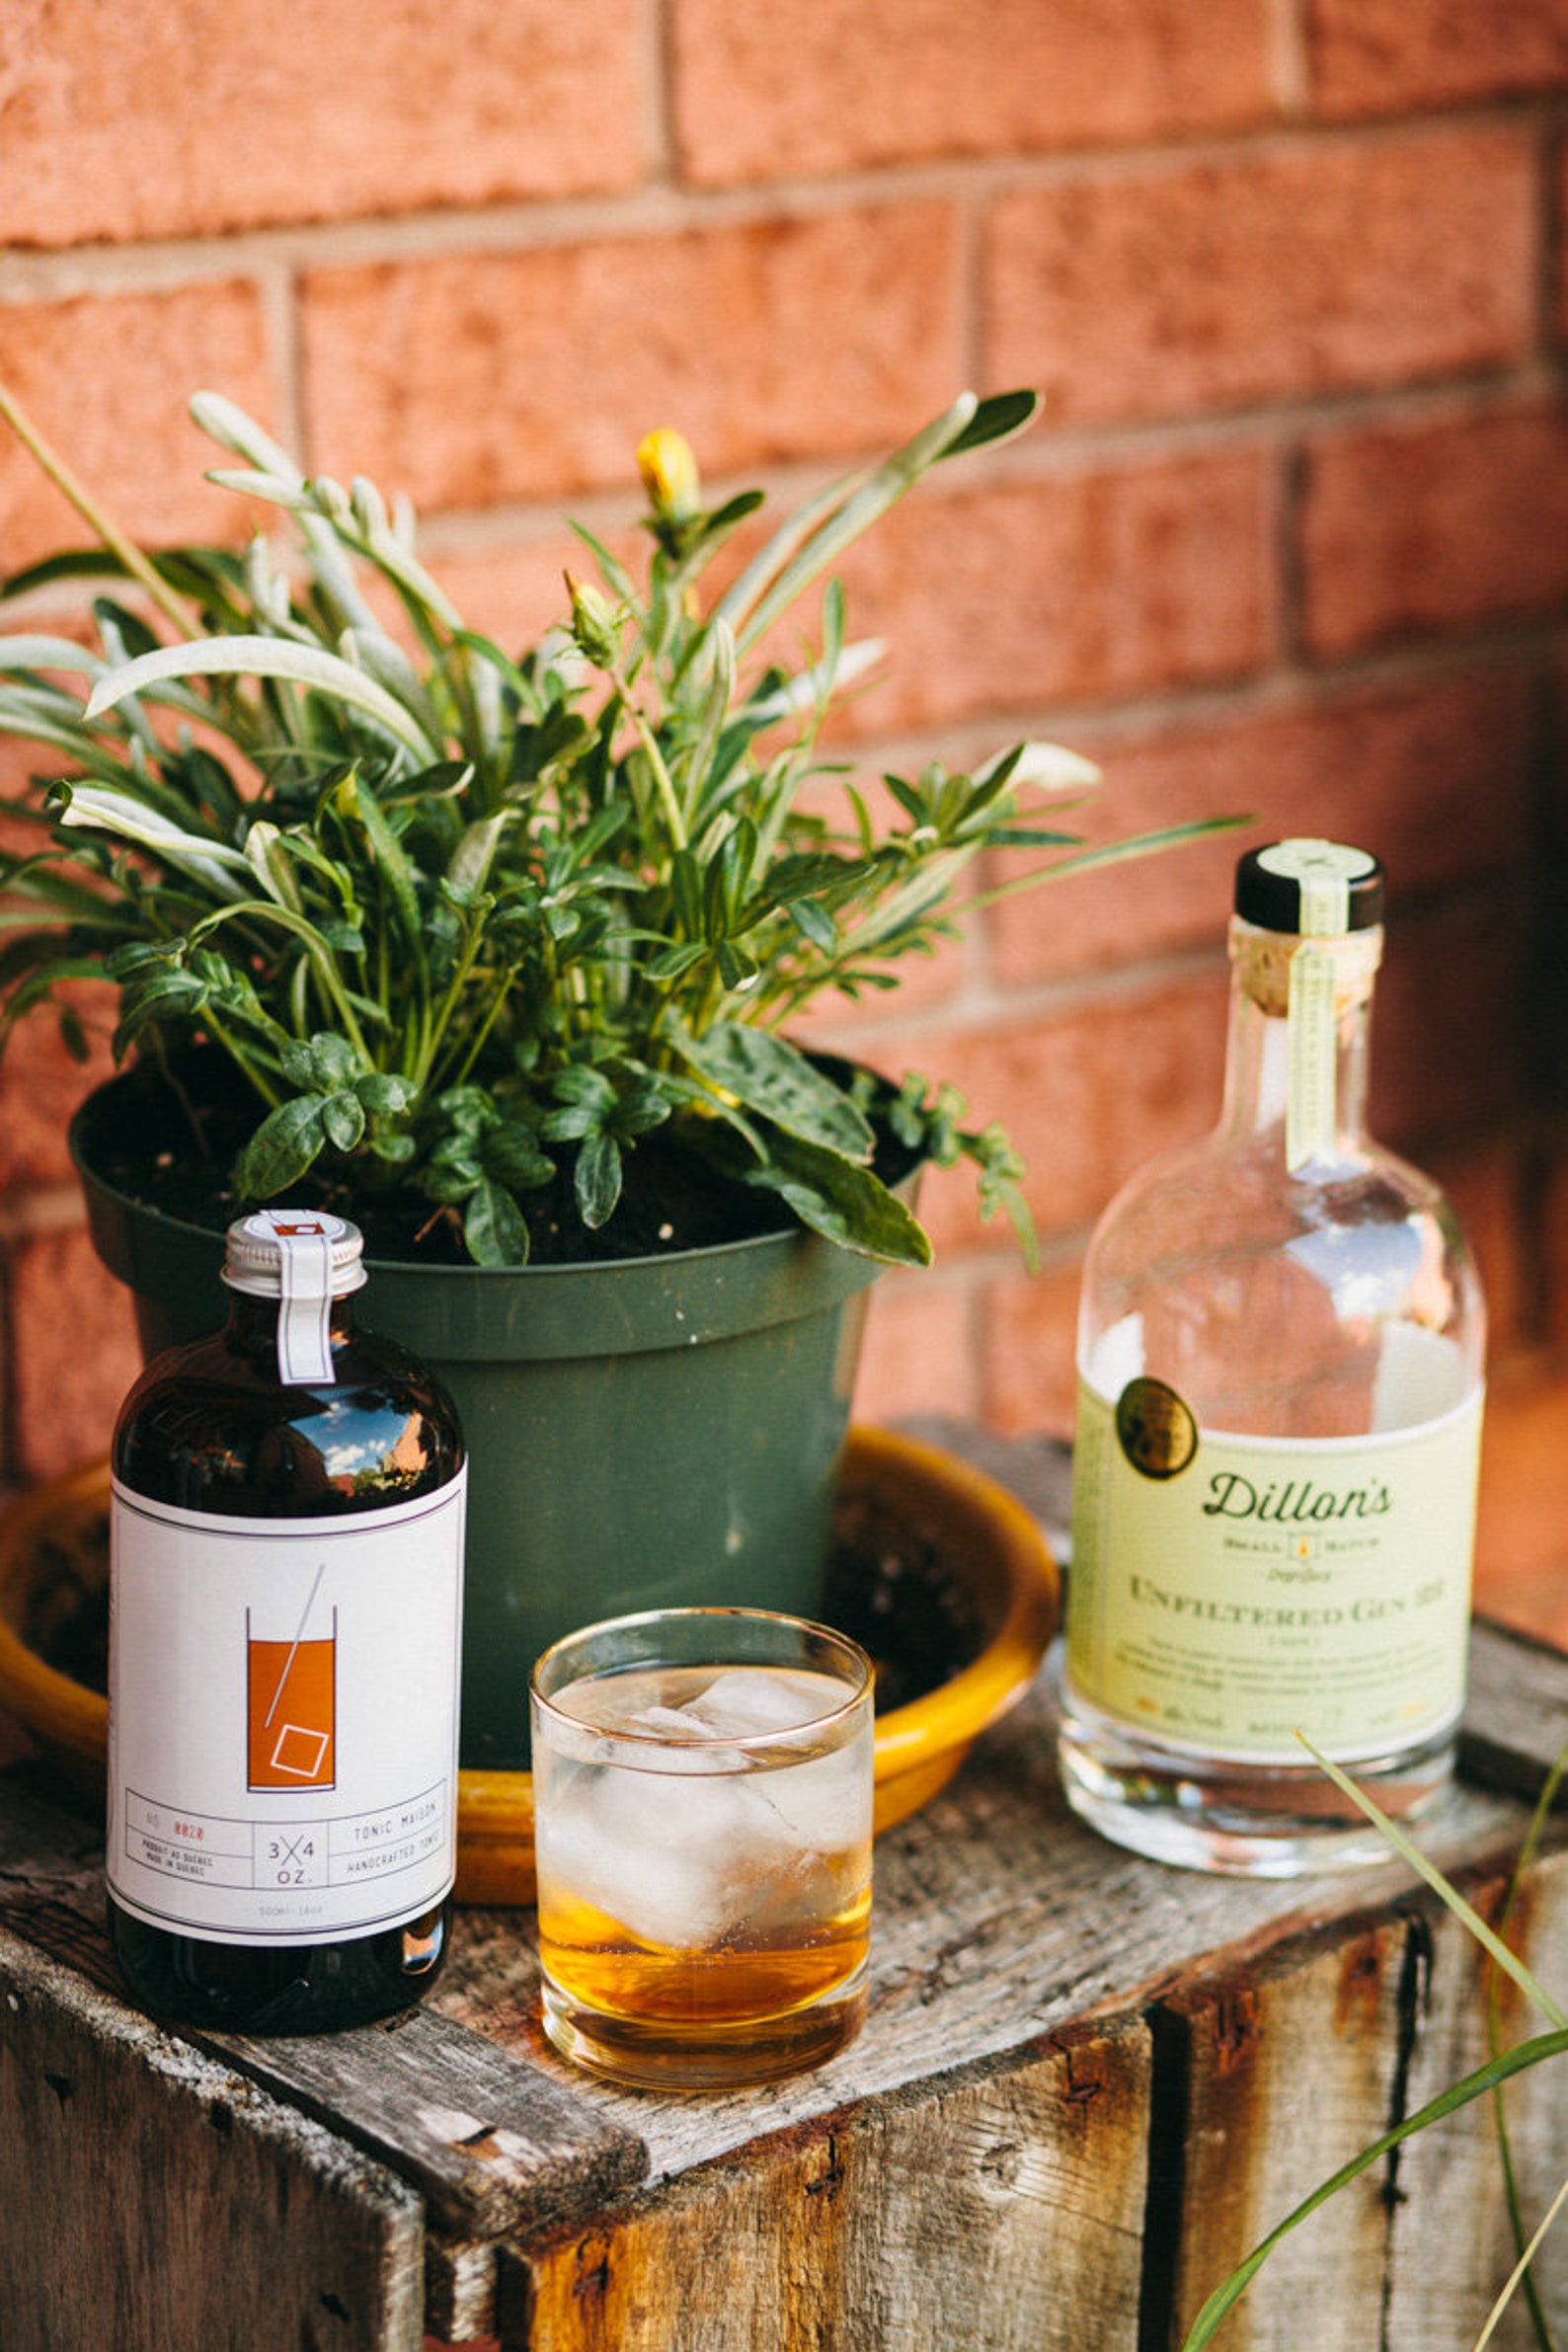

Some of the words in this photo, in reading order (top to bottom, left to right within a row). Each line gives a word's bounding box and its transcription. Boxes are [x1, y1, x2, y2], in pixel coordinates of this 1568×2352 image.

[1203, 1472, 1393, 1522] Dillon's
[1131, 1575, 1344, 1627] UNFILTERED
[354, 1820, 393, 1842] TONIC
[401, 1802, 436, 1828] MAISON
[347, 1843, 416, 1874] HANDCRAFTED
